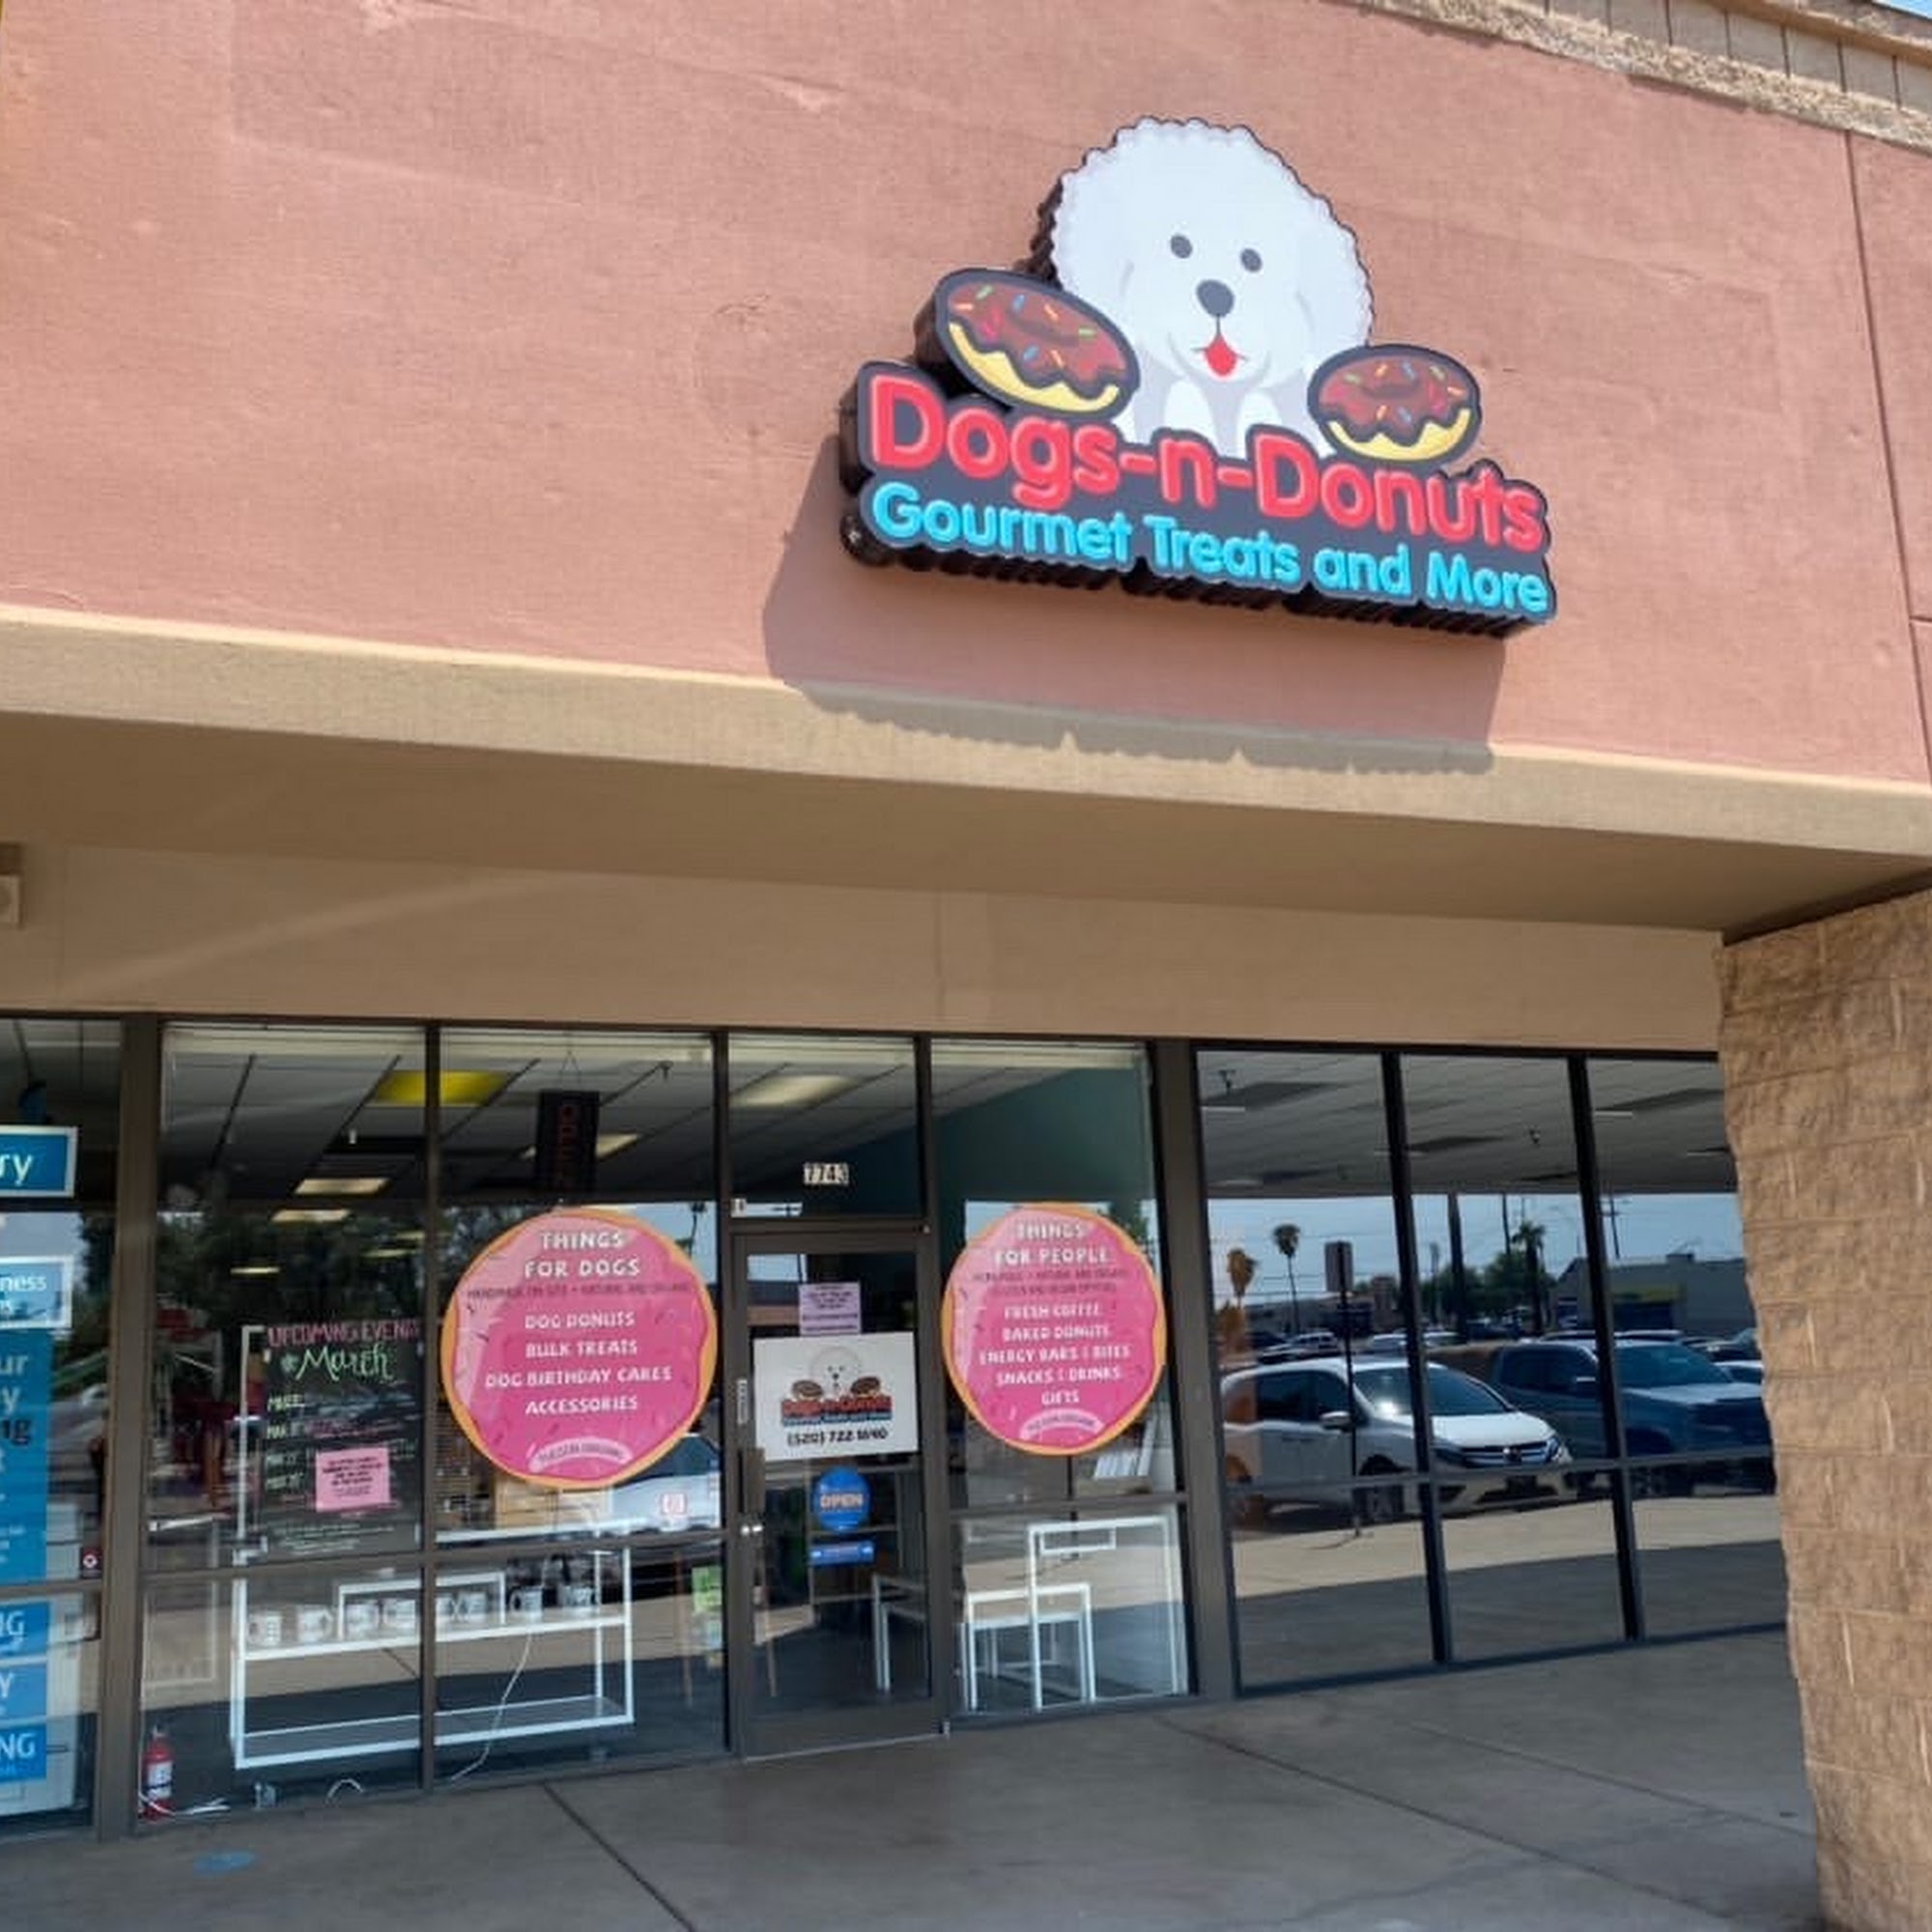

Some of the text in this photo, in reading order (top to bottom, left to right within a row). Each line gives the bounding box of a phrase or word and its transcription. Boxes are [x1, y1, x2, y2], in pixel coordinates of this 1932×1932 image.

[869, 372, 1545, 552] Dogs-n-Donuts
[872, 482, 1548, 613] Gourmet Treats and More
[541, 1232, 626, 1250] THINGS
[995, 1247, 1110, 1266] FOR PEOPLE
[525, 1259, 641, 1279] FOR DOGS
[525, 1311, 636, 1329] DOG DONUTS
[1002, 1326, 1050, 1342] BAKED
[526, 1338, 638, 1359] BULK TREATS
[979, 1349, 1036, 1366] ENERGY
[295, 1342, 394, 1381] March
[485, 1365, 673, 1388] DOG BIRTHDAY CAKES
[996, 1368, 1055, 1386] SNACKS
[1068, 1365, 1122, 1381] DRINKS
[525, 1396, 639, 1415] ACCESSORIES
